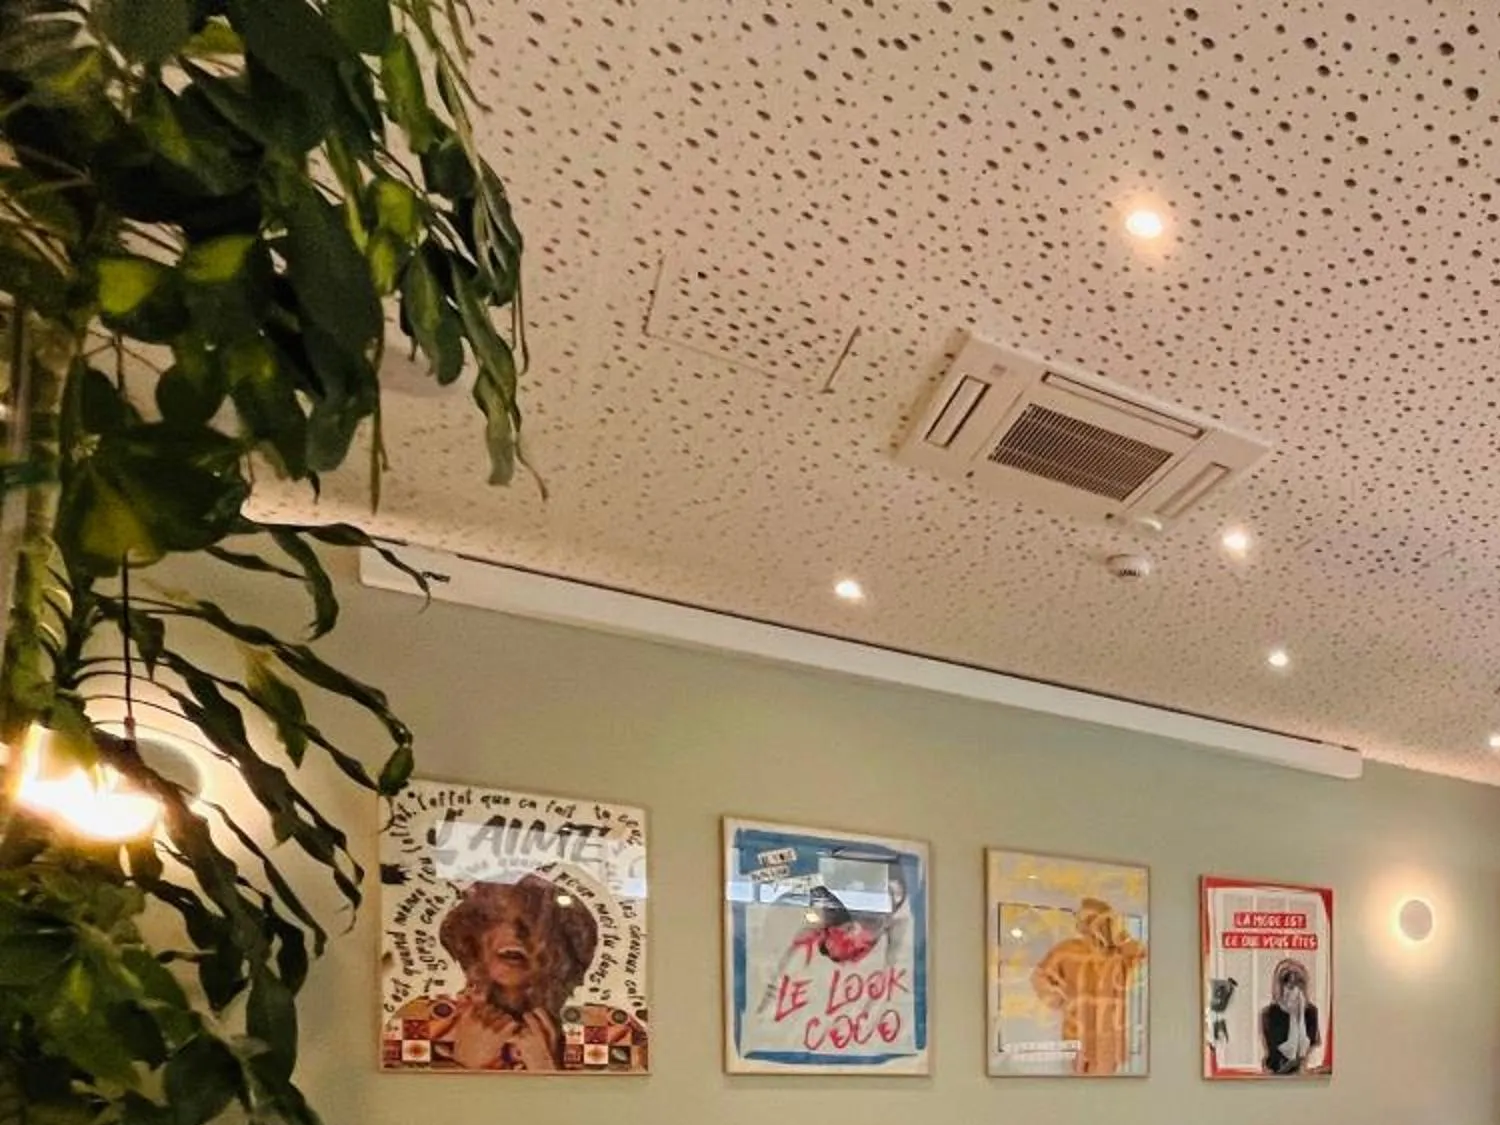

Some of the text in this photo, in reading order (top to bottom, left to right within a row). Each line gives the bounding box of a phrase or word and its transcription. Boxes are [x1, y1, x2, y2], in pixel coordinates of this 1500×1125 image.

[774, 967, 910, 1022] LE LOOK
[803, 1008, 902, 1051] COCO
